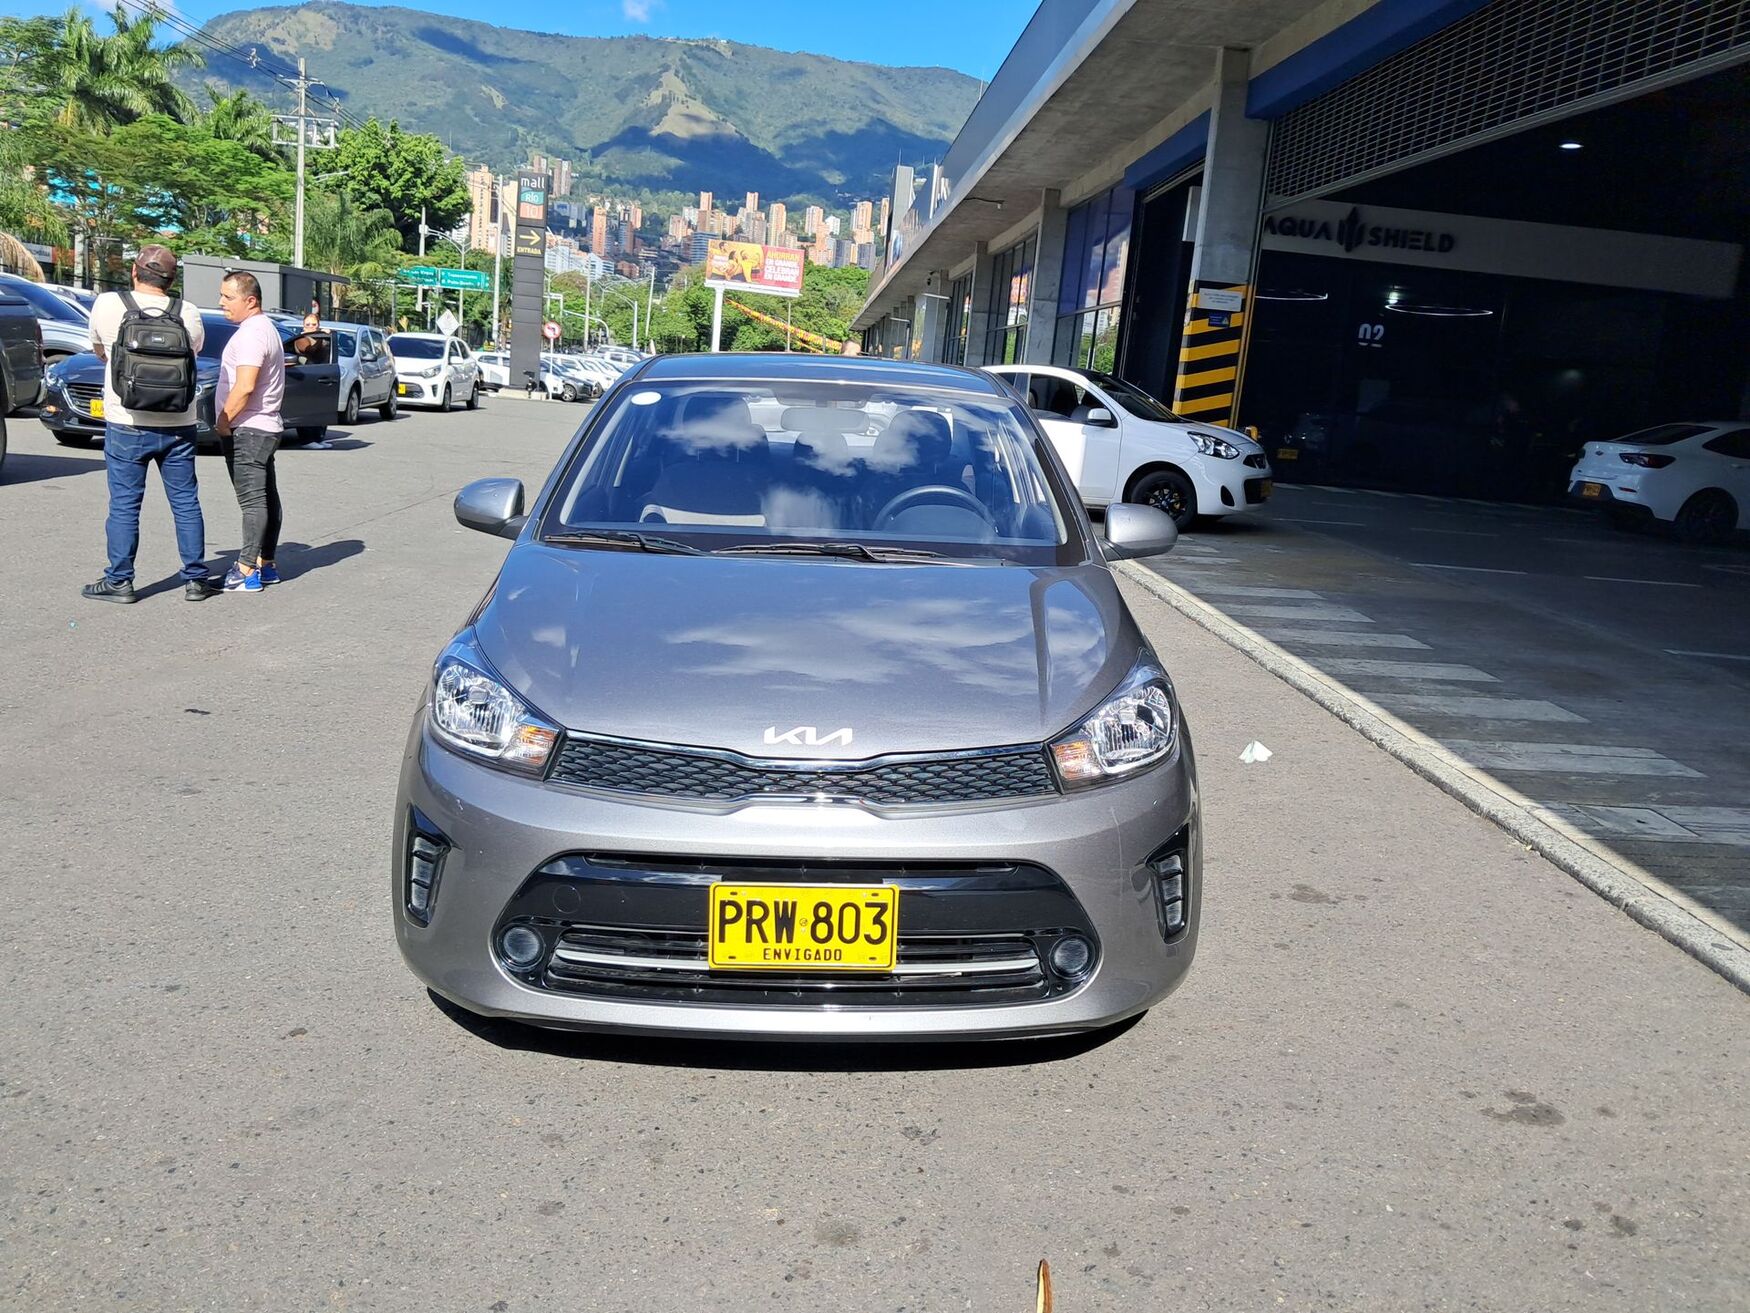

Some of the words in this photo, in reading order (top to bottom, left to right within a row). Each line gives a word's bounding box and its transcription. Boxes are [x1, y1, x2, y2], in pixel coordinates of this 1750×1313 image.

[521, 177, 545, 189] mall
[1264, 216, 1333, 241] AQUA
[1368, 226, 1456, 253] SHIELD
[517, 246, 542, 255] ENTRADA
[1358, 323, 1385, 348] 02
[763, 726, 853, 746] KIA
[718, 900, 797, 944] PRW
[810, 901, 889, 945] 803
[763, 948, 842, 961] ENVIGADO
